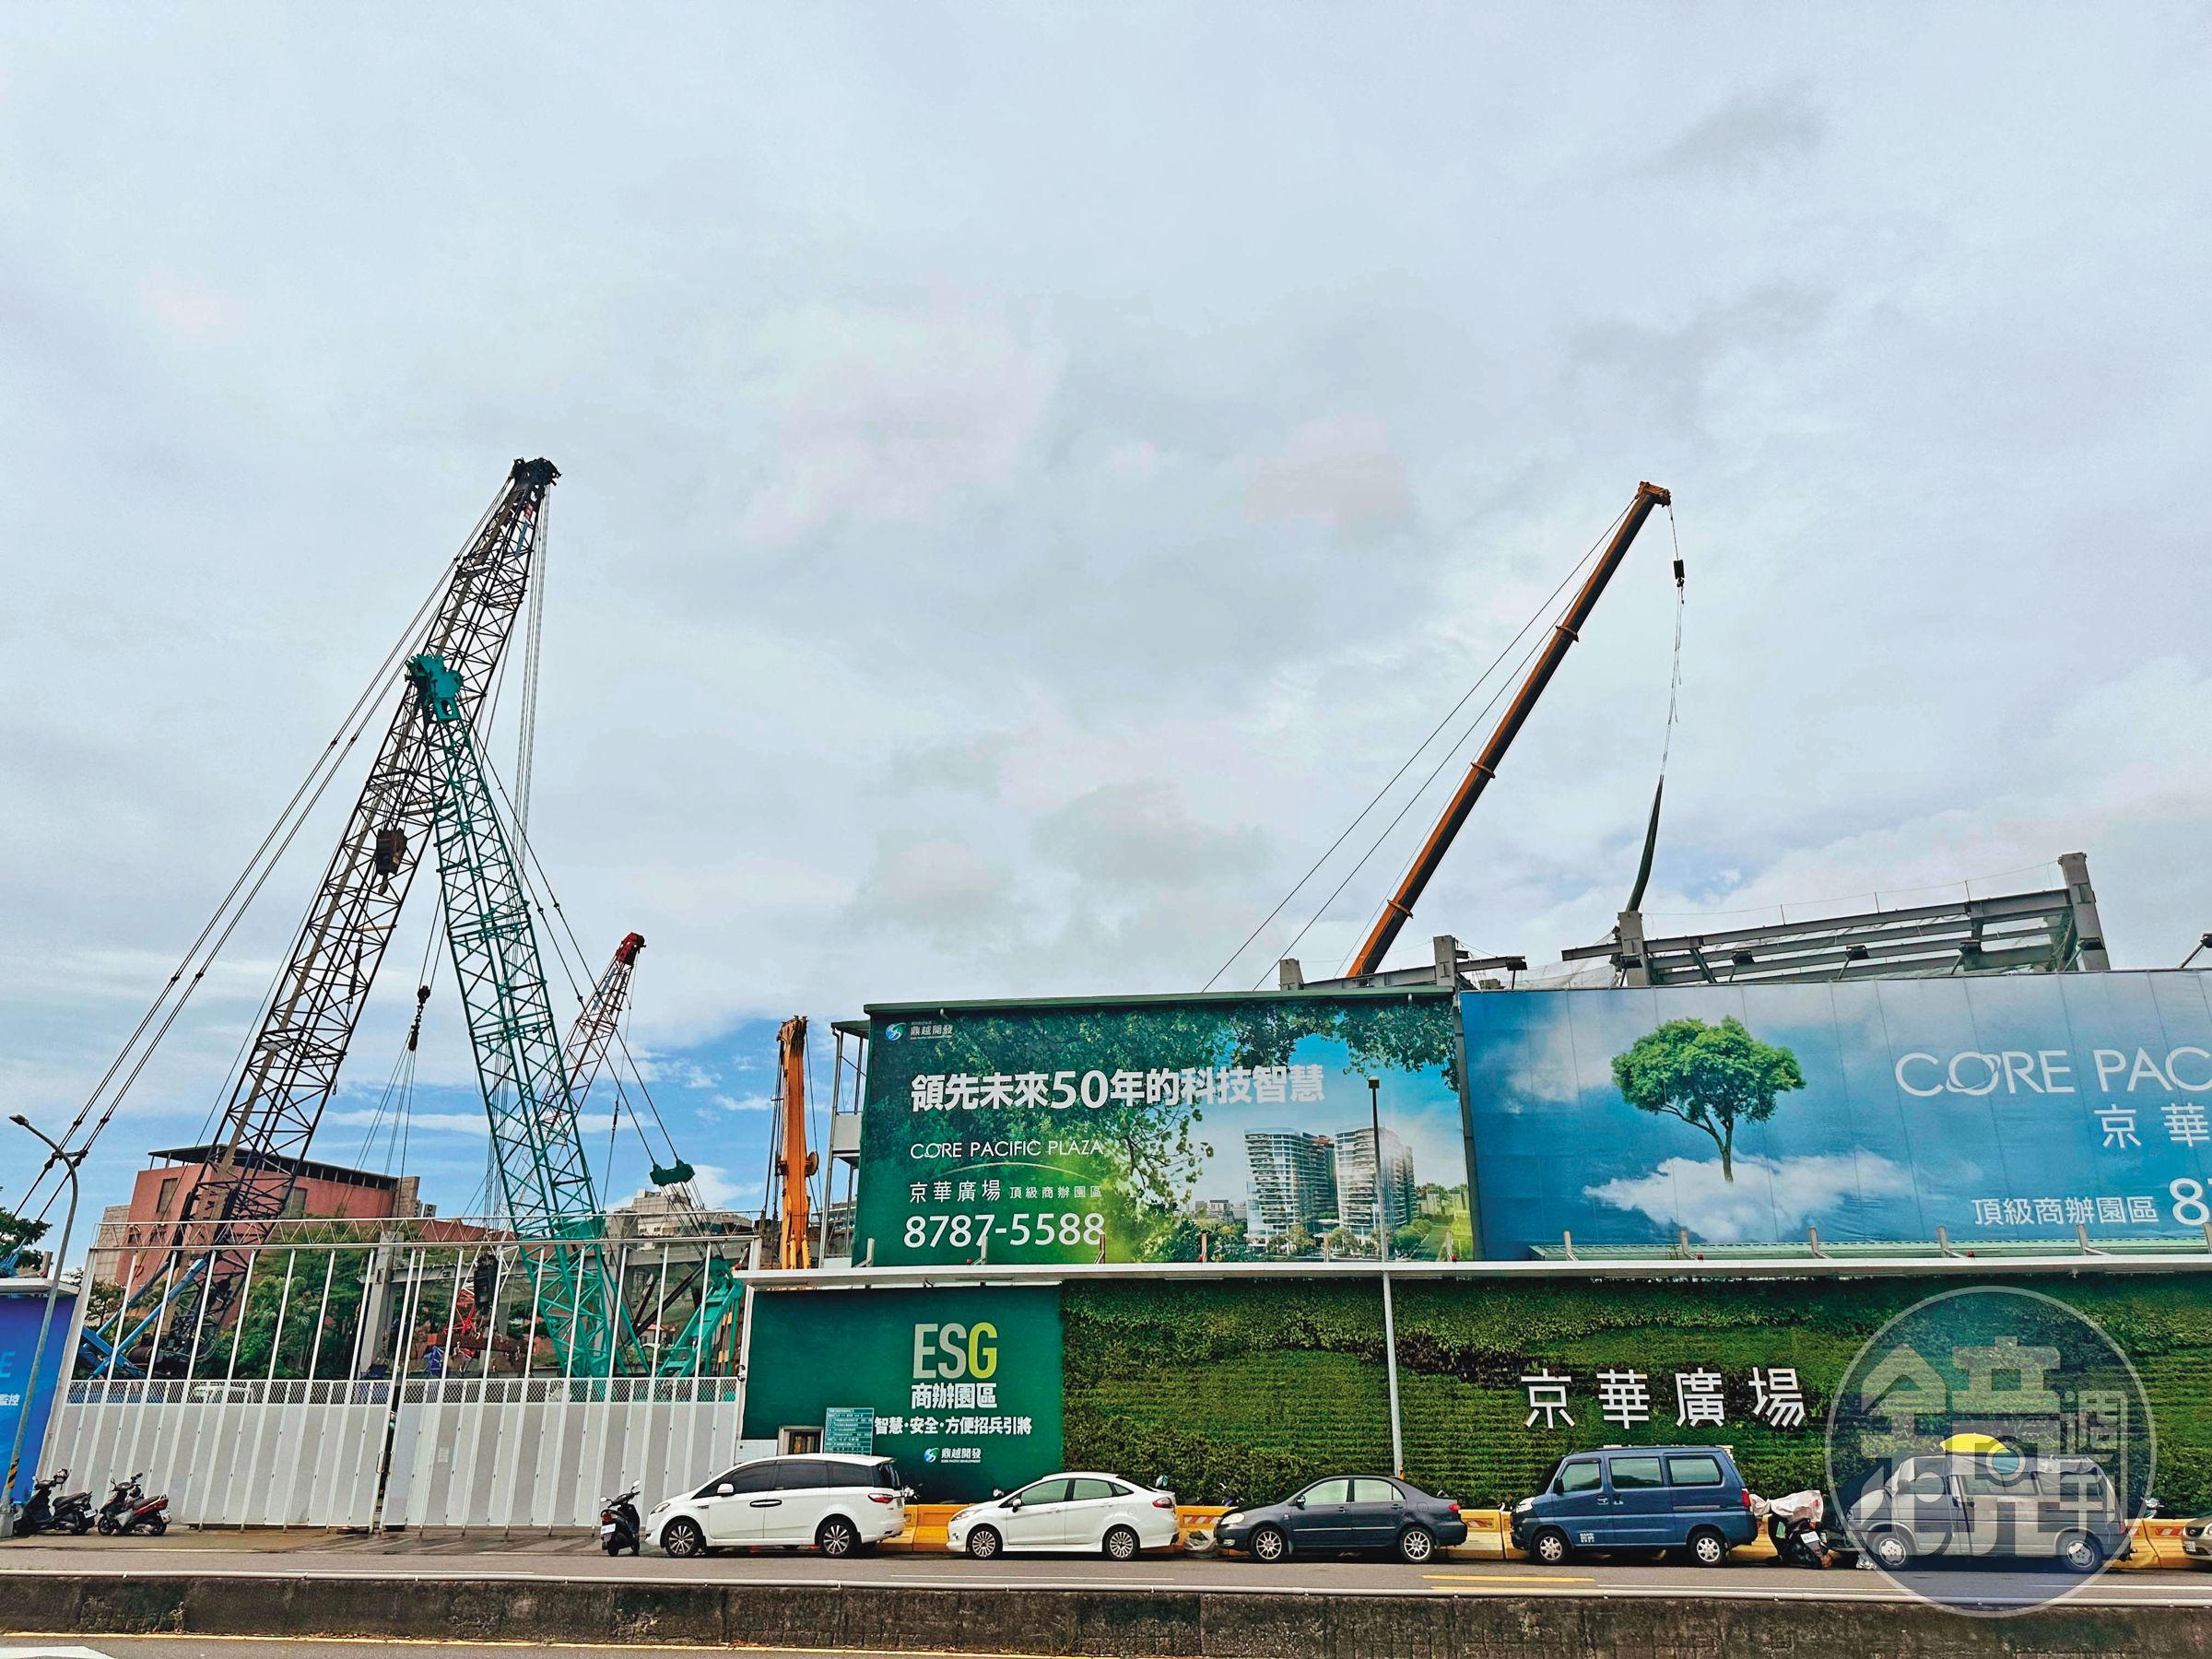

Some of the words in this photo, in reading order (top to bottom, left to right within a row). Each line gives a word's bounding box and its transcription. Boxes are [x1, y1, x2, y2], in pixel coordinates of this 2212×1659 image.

[911, 1064, 1325, 1112] 領先未來50年的科技智慧
[1895, 1051, 2075, 1096] CORE
[2093, 1102, 2211, 1149] 京華
[910, 1142, 962, 1159] CORE
[971, 1140, 1041, 1158] PACIFIC
[1048, 1139, 1104, 1156] PLAZA
[910, 1180, 1001, 1204] 京華廣場
[1971, 1196, 2159, 1226] 頂級商辦園區
[2170, 1177, 2212, 1226] 8
[903, 1212, 1105, 1248] 8787-5588
[913, 1322, 998, 1380] ESG
[911, 1382, 997, 1409] 商辦園區
[1521, 1367, 1806, 1430] 京華廣場
